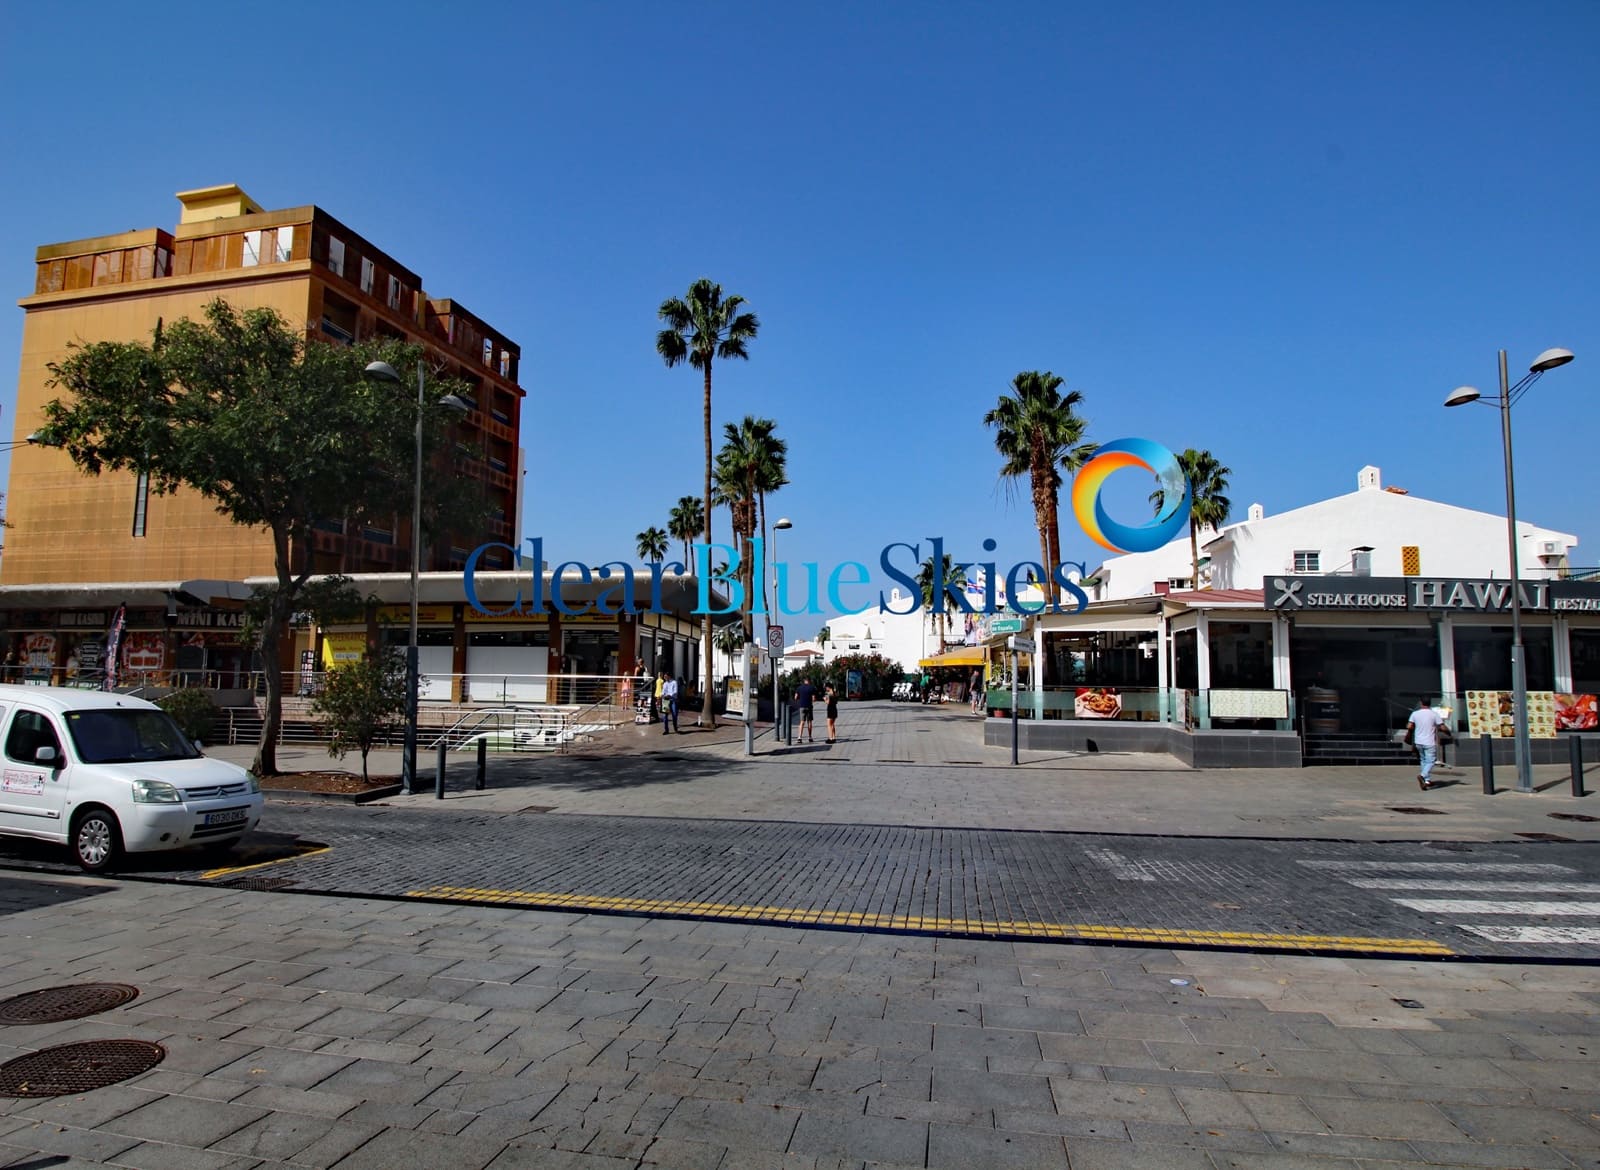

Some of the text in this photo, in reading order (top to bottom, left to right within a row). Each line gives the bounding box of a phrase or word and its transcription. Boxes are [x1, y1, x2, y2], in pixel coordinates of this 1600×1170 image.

[1307, 593, 1406, 606] STEAK HOUSE
[1412, 581, 1549, 609] HAWAI
[178, 612, 211, 626] MINI
